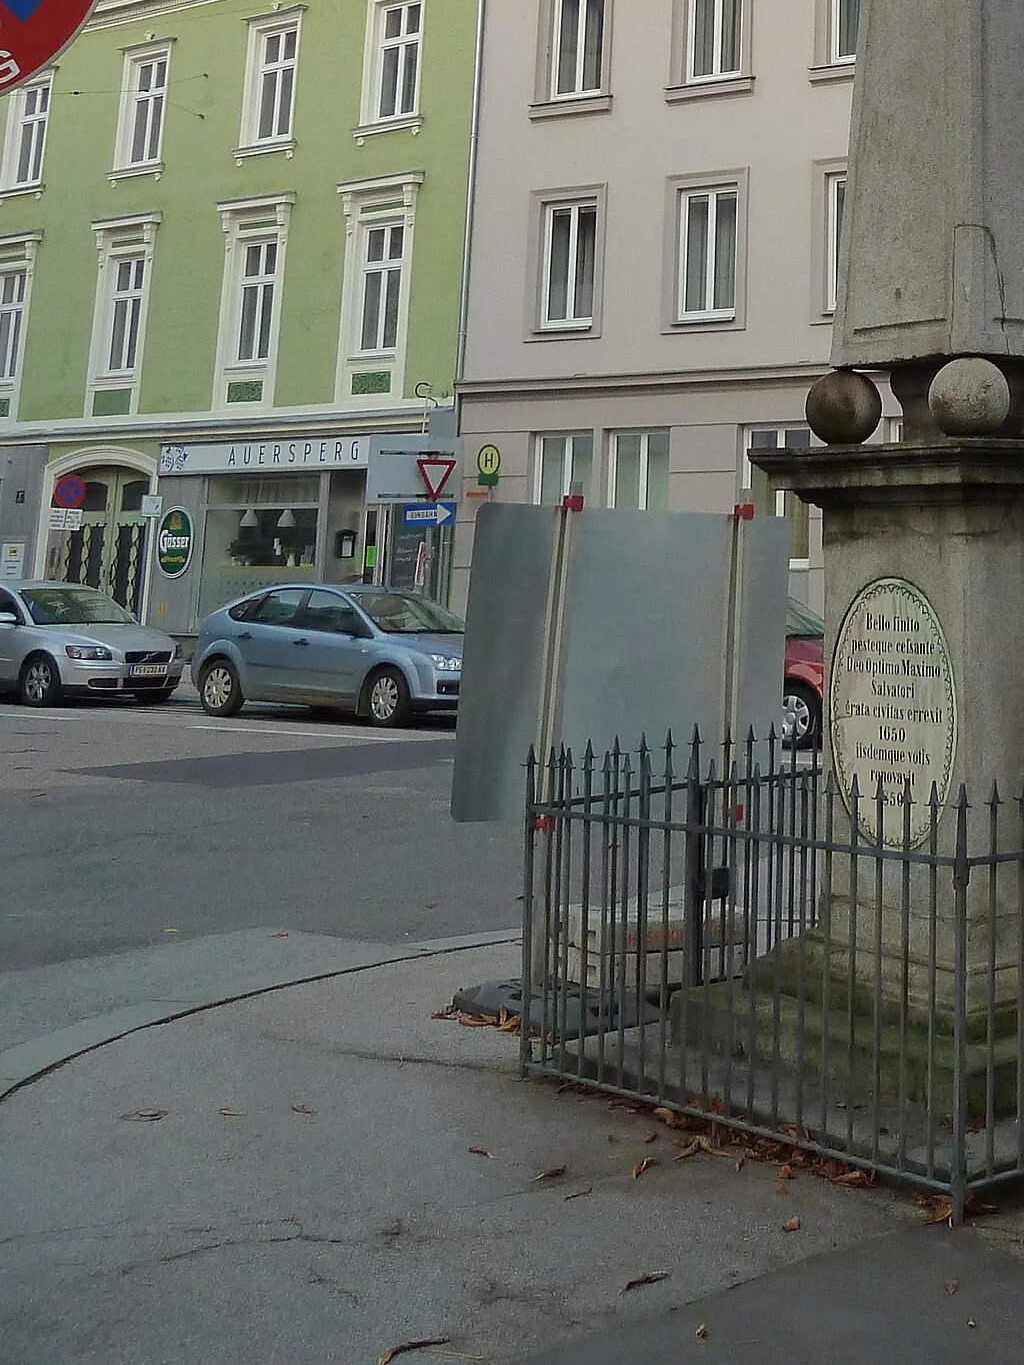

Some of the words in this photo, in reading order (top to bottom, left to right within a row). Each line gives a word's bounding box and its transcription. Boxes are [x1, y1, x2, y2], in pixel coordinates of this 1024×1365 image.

[228, 441, 359, 466] AUERSPERG
[484, 452, 494, 468] H
[866, 612, 890, 631] Bello
[893, 615, 920, 632] finito
[851, 639, 893, 655] pesteque
[847, 655, 864, 672] Deo
[865, 657, 900, 677] Optimo
[901, 659, 941, 677] Maximo
[871, 679, 915, 698] Salvatori
[873, 702, 904, 720] civitas
[907, 706, 943, 723] errexit
[879, 725, 906, 743] 1650
[907, 748, 931, 766] votis
